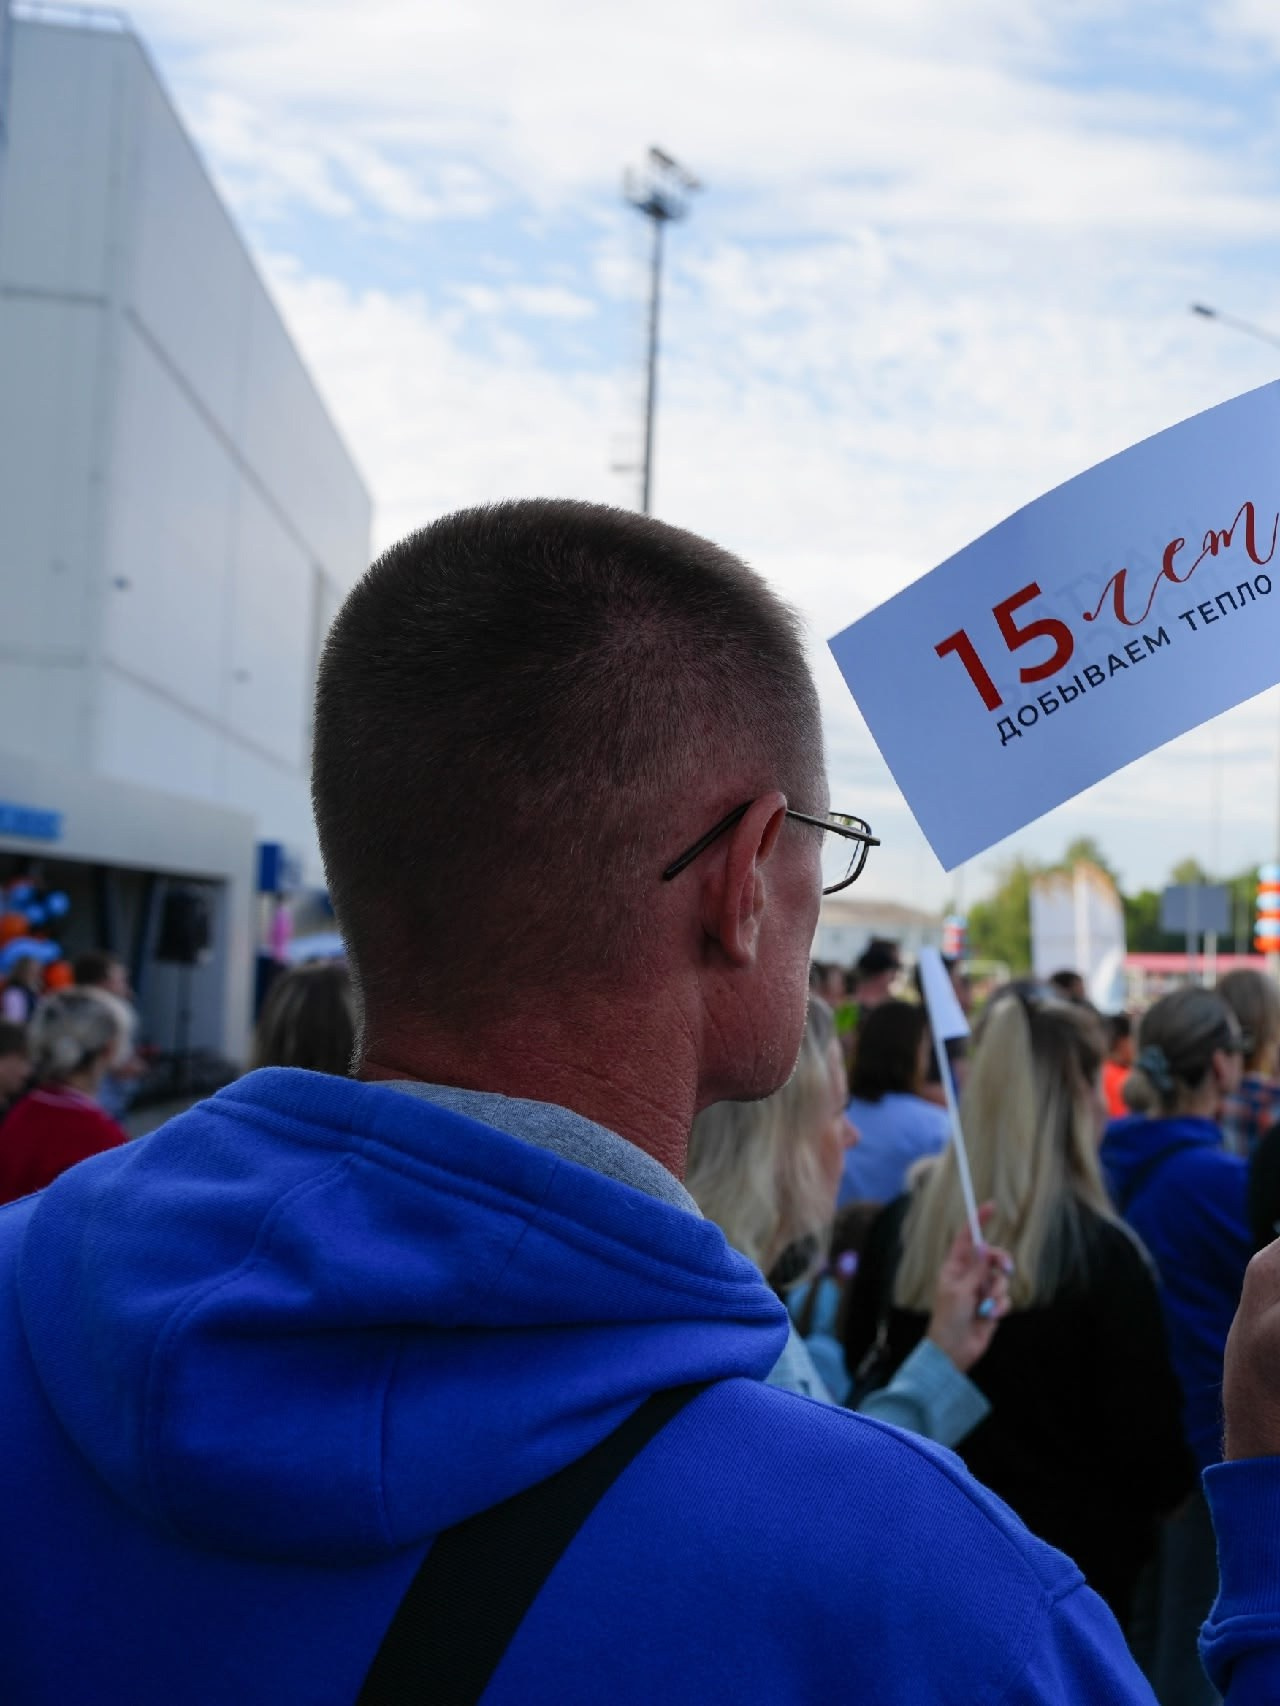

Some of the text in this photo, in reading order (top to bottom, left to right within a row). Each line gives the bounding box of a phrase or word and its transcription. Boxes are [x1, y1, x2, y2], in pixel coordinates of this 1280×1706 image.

[934, 581, 1075, 712] 15
[1082, 501, 1280, 626] лет
[996, 574, 1273, 747] ДОБЫВАЕМ ТЕПЛО
